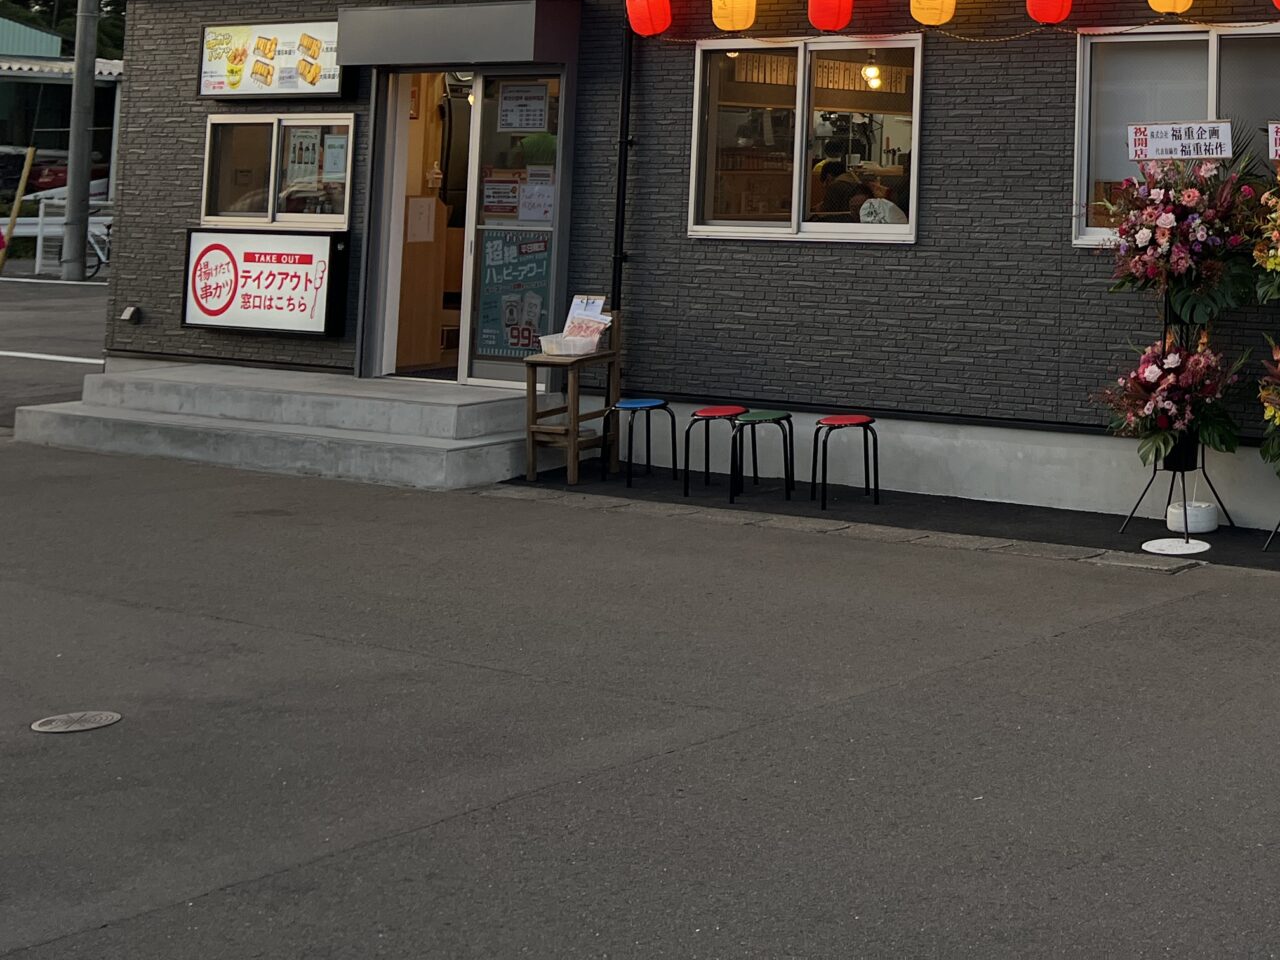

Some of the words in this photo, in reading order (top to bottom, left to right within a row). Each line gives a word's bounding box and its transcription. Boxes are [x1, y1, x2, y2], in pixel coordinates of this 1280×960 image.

[1133, 126, 1149, 159] 祝開店
[1171, 125, 1220, 141] 福重企画
[1180, 141, 1226, 156] 福重祐作
[254, 253, 277, 263] TAKE
[281, 254, 300, 264] OUT
[485, 240, 518, 266] 超絶
[197, 260, 231, 282] 揚げたて
[240, 269, 313, 292] テイクアウト
[200, 278, 233, 304] 串カツ
[240, 292, 308, 313] 窓口はこちら
